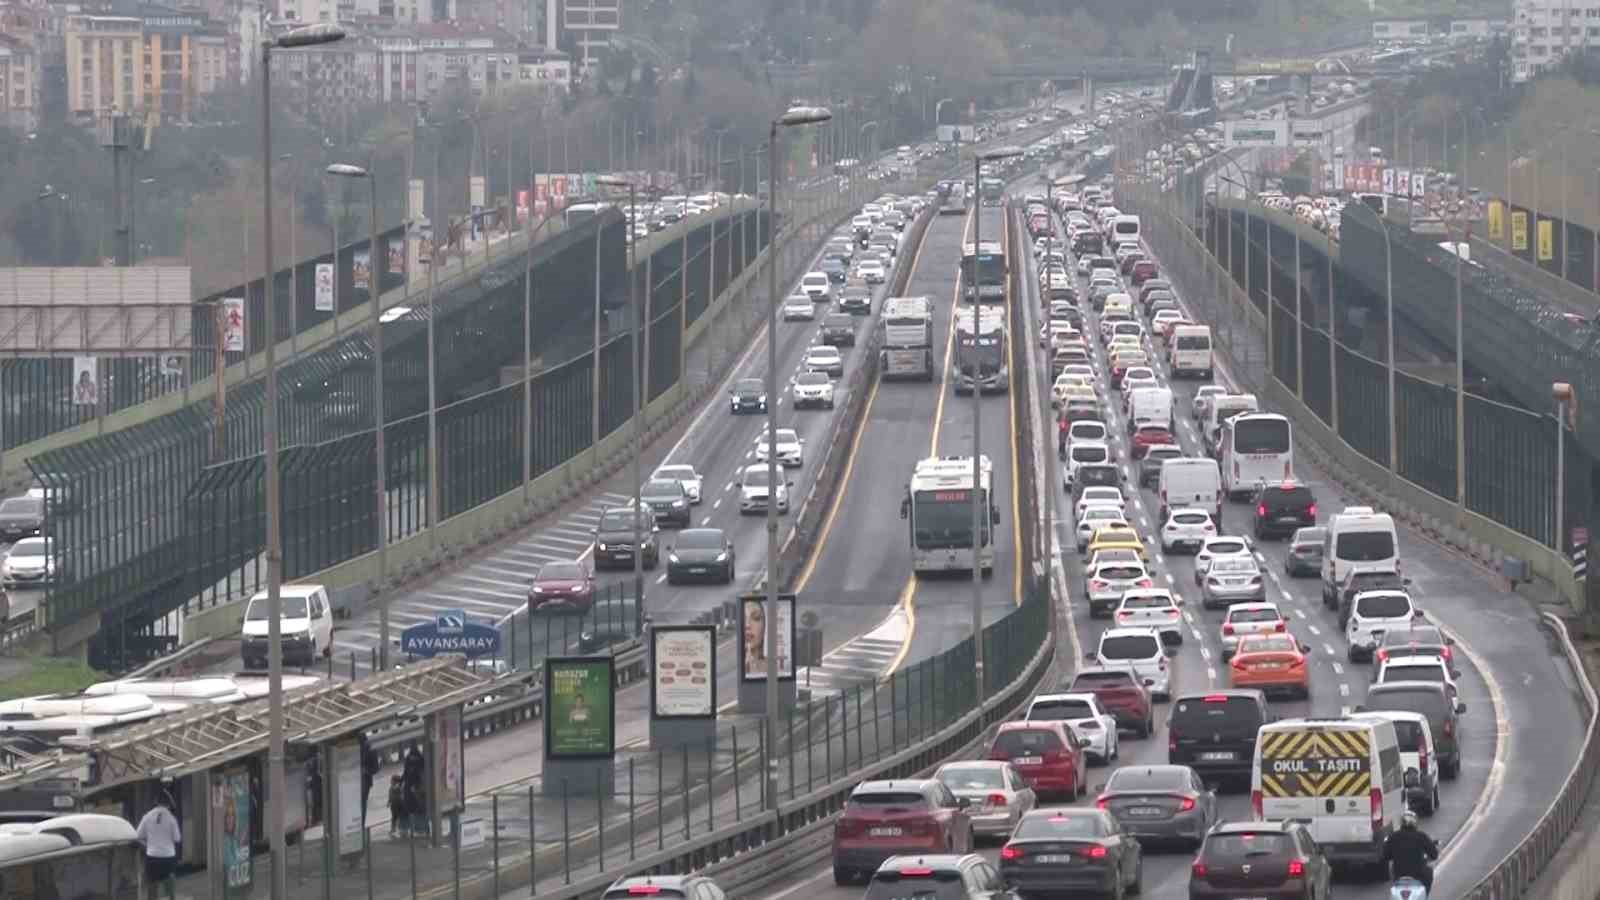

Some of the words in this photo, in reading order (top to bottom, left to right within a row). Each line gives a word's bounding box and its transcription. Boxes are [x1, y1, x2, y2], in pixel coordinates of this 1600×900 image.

[408, 637, 494, 649] AYVANSARAY
[1273, 760, 1308, 772] OKUL
[1319, 759, 1360, 773] TAŞITI
